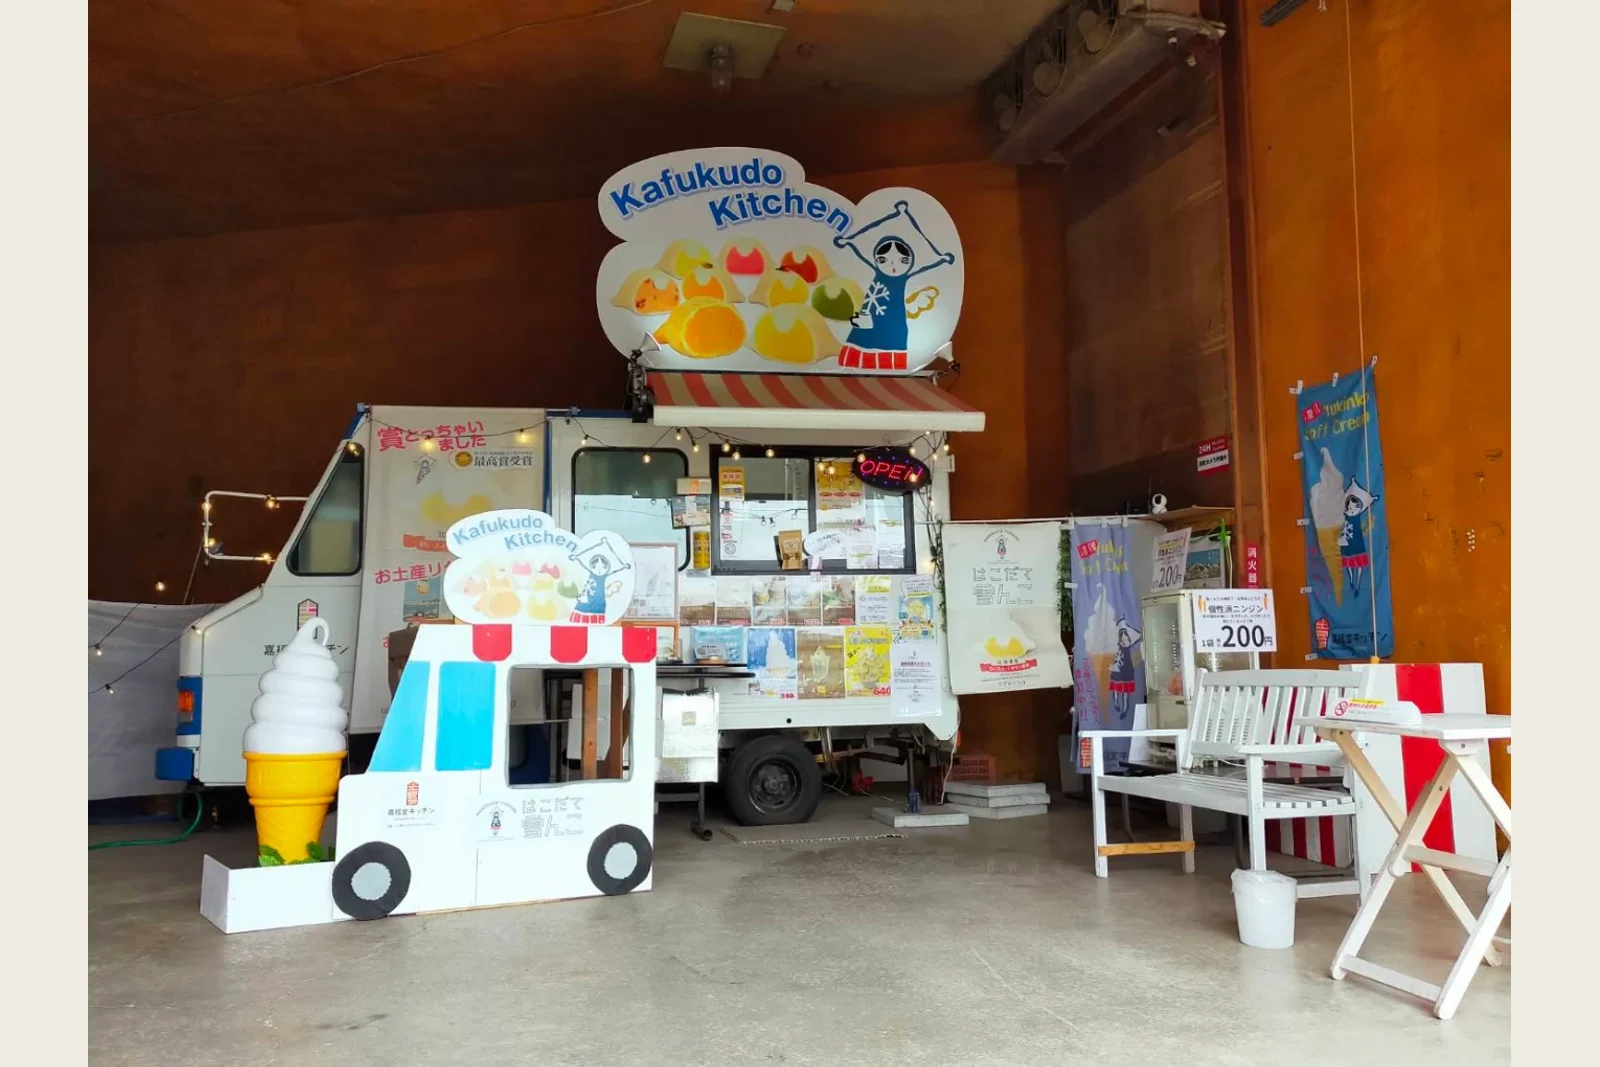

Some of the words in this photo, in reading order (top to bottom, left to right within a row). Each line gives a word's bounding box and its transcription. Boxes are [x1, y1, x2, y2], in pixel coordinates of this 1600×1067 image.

[609, 156, 784, 217] Kafukudo
[708, 187, 855, 233] Kitchen
[377, 419, 484, 451] 賞とっちゃい
[438, 434, 487, 451] ました
[473, 455, 534, 467] 最高賞受賞
[859, 460, 924, 481] OPEN
[452, 514, 544, 545] Kafukudo
[504, 528, 579, 553] Kitchen
[374, 560, 451, 584] お土産リ
[1247, 547, 1257, 583] 消火器
[1208, 604, 1263, 614] 個性派ニンジン
[1221, 624, 1274, 648] 200円
